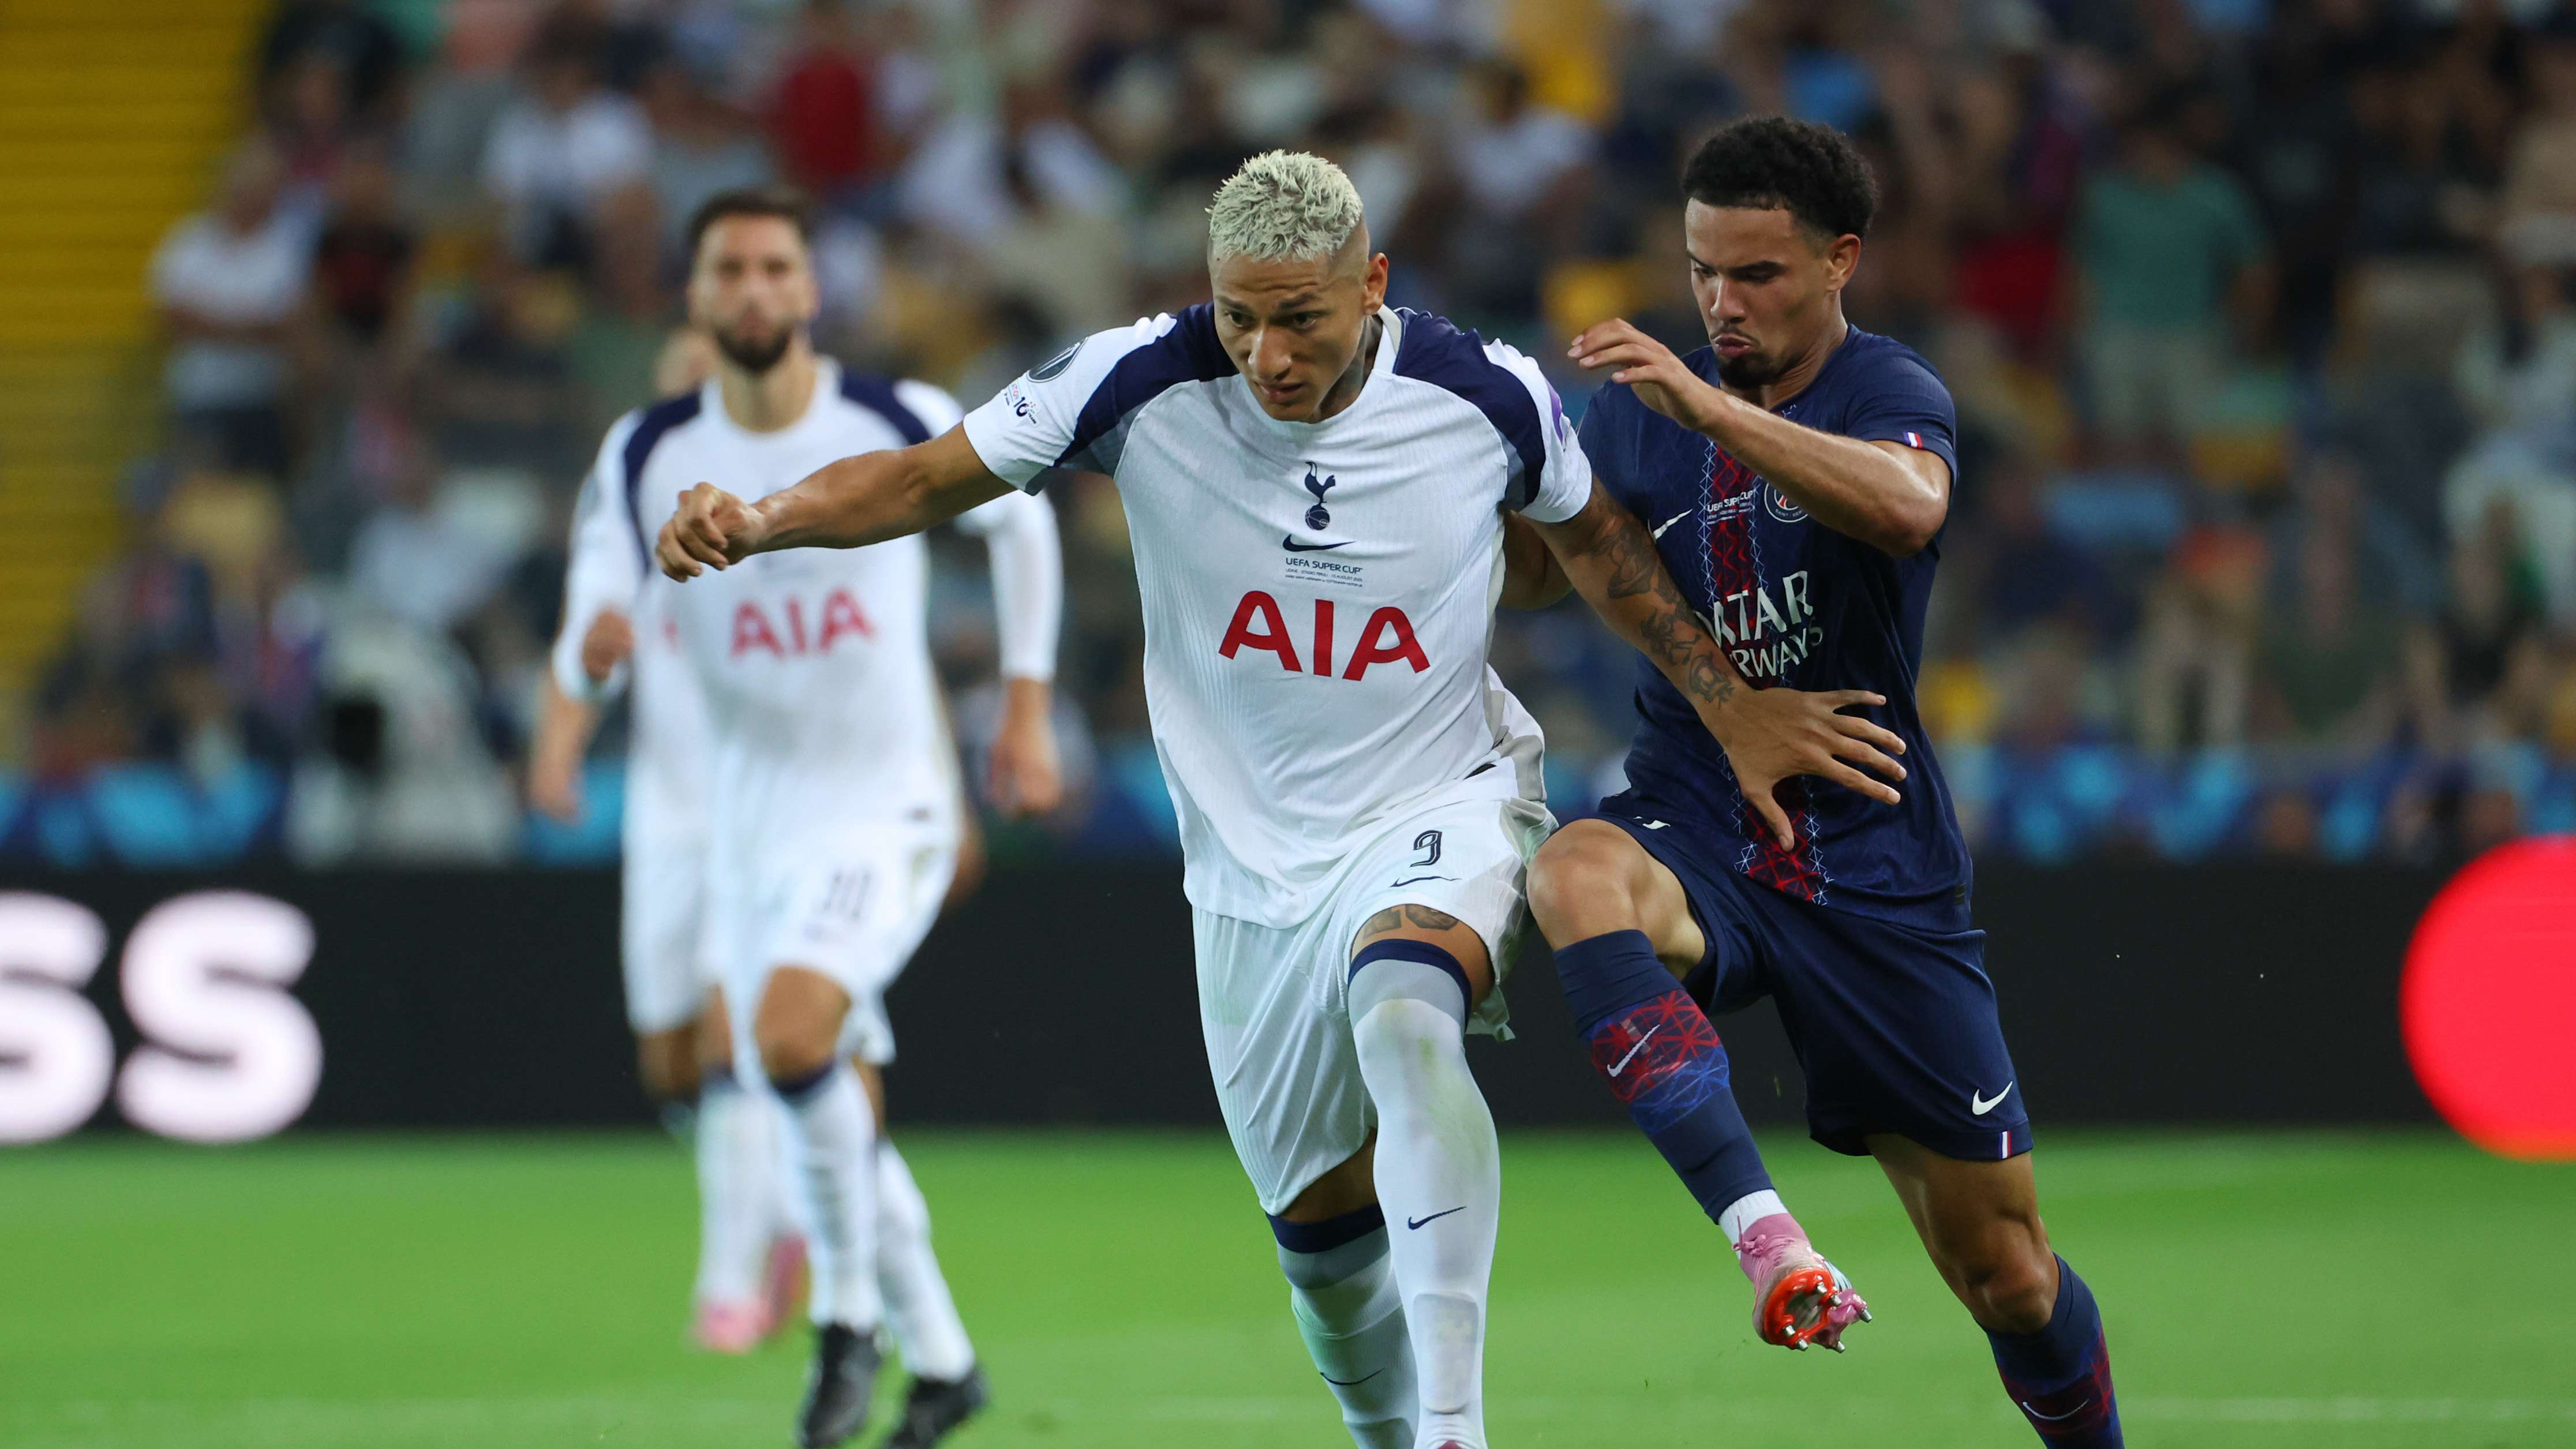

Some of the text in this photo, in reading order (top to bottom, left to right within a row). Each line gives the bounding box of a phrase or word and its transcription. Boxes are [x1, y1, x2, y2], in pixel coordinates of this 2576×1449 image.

[1285, 557, 1310, 567] UEFA
[1312, 560, 1341, 572] SUPER
[729, 586, 878, 661] AIA
[1219, 590, 1431, 681] AIA
[1409, 830, 1443, 867] 9
